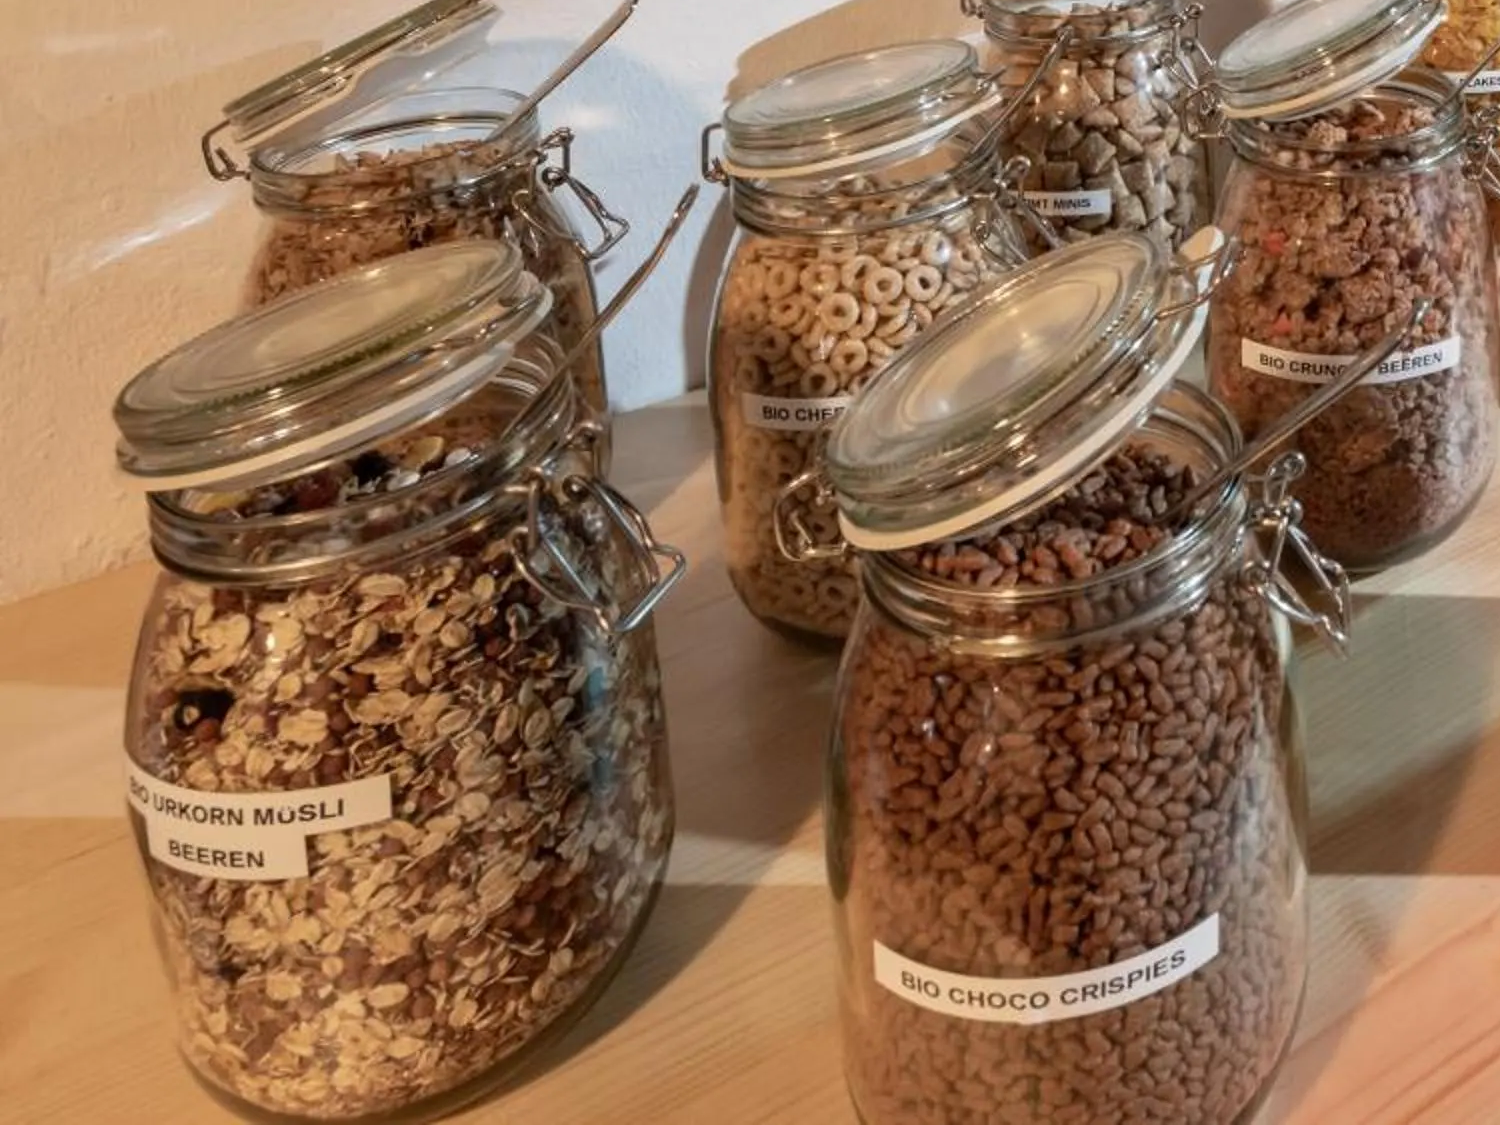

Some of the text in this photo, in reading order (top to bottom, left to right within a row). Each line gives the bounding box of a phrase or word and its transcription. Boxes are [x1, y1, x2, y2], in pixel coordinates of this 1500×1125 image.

[1053, 197, 1092, 210] MINIS
[1259, 350, 1444, 378] BIO CRUNC BEEREN
[762, 405, 790, 421] BIO
[153, 791, 245, 826] URKORN
[168, 838, 266, 869] BEEREN
[900, 948, 1188, 1012] BIO CHOCO CRISPIES
